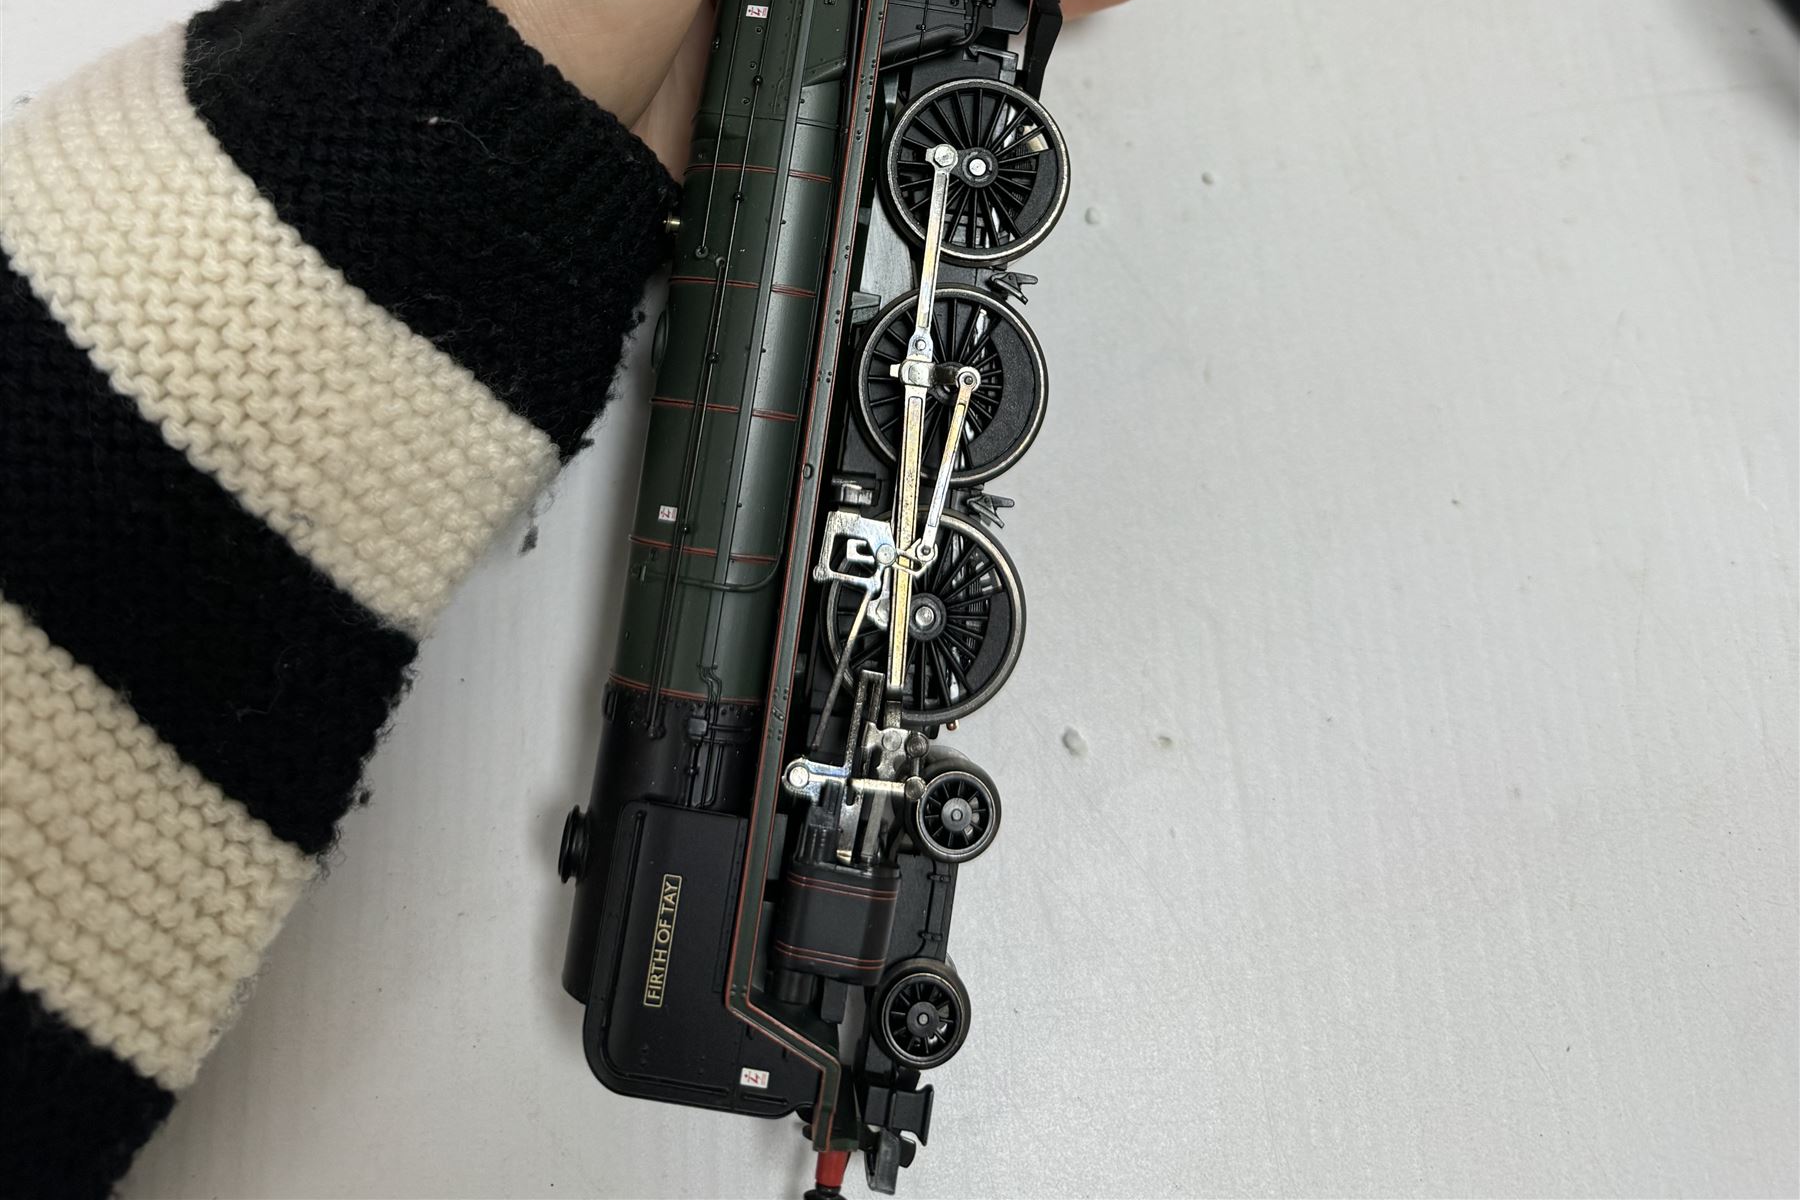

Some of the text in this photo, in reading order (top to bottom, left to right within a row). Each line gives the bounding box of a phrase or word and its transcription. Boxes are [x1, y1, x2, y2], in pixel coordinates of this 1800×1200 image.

[647, 881, 678, 1000] FIRTH OF TAY
